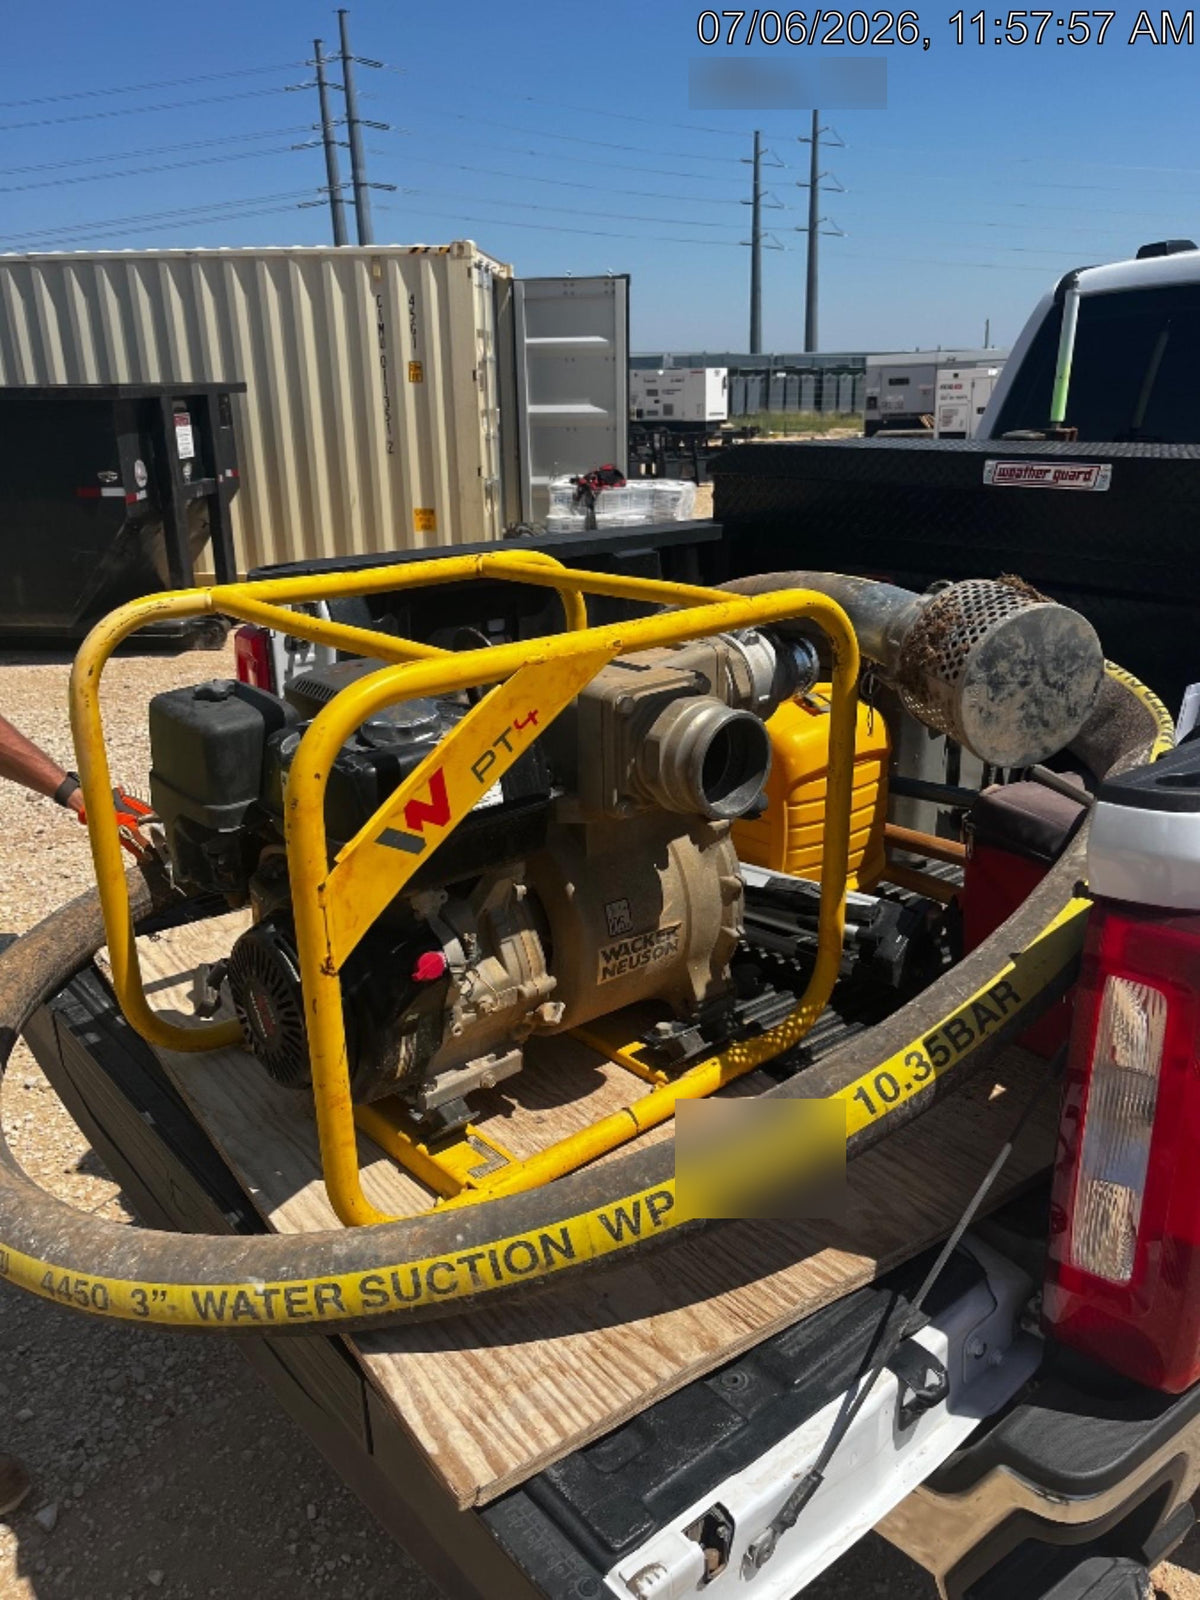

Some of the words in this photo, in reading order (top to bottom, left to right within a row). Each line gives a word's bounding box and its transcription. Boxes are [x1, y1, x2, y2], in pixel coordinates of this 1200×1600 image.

[998, 465, 1051, 479] weather
[1052, 468, 1094, 482] guard
[470, 709, 539, 784] PT4
[600, 926, 681, 963] WACKER
[602, 938, 679, 980] NEUSON
[853, 980, 1022, 1116] 10.35BAR
[40, 1270, 110, 1310] 4450
[192, 1282, 347, 1322] WATER
[358, 1227, 576, 1308] SUCTION
[598, 1190, 676, 1243] WP
